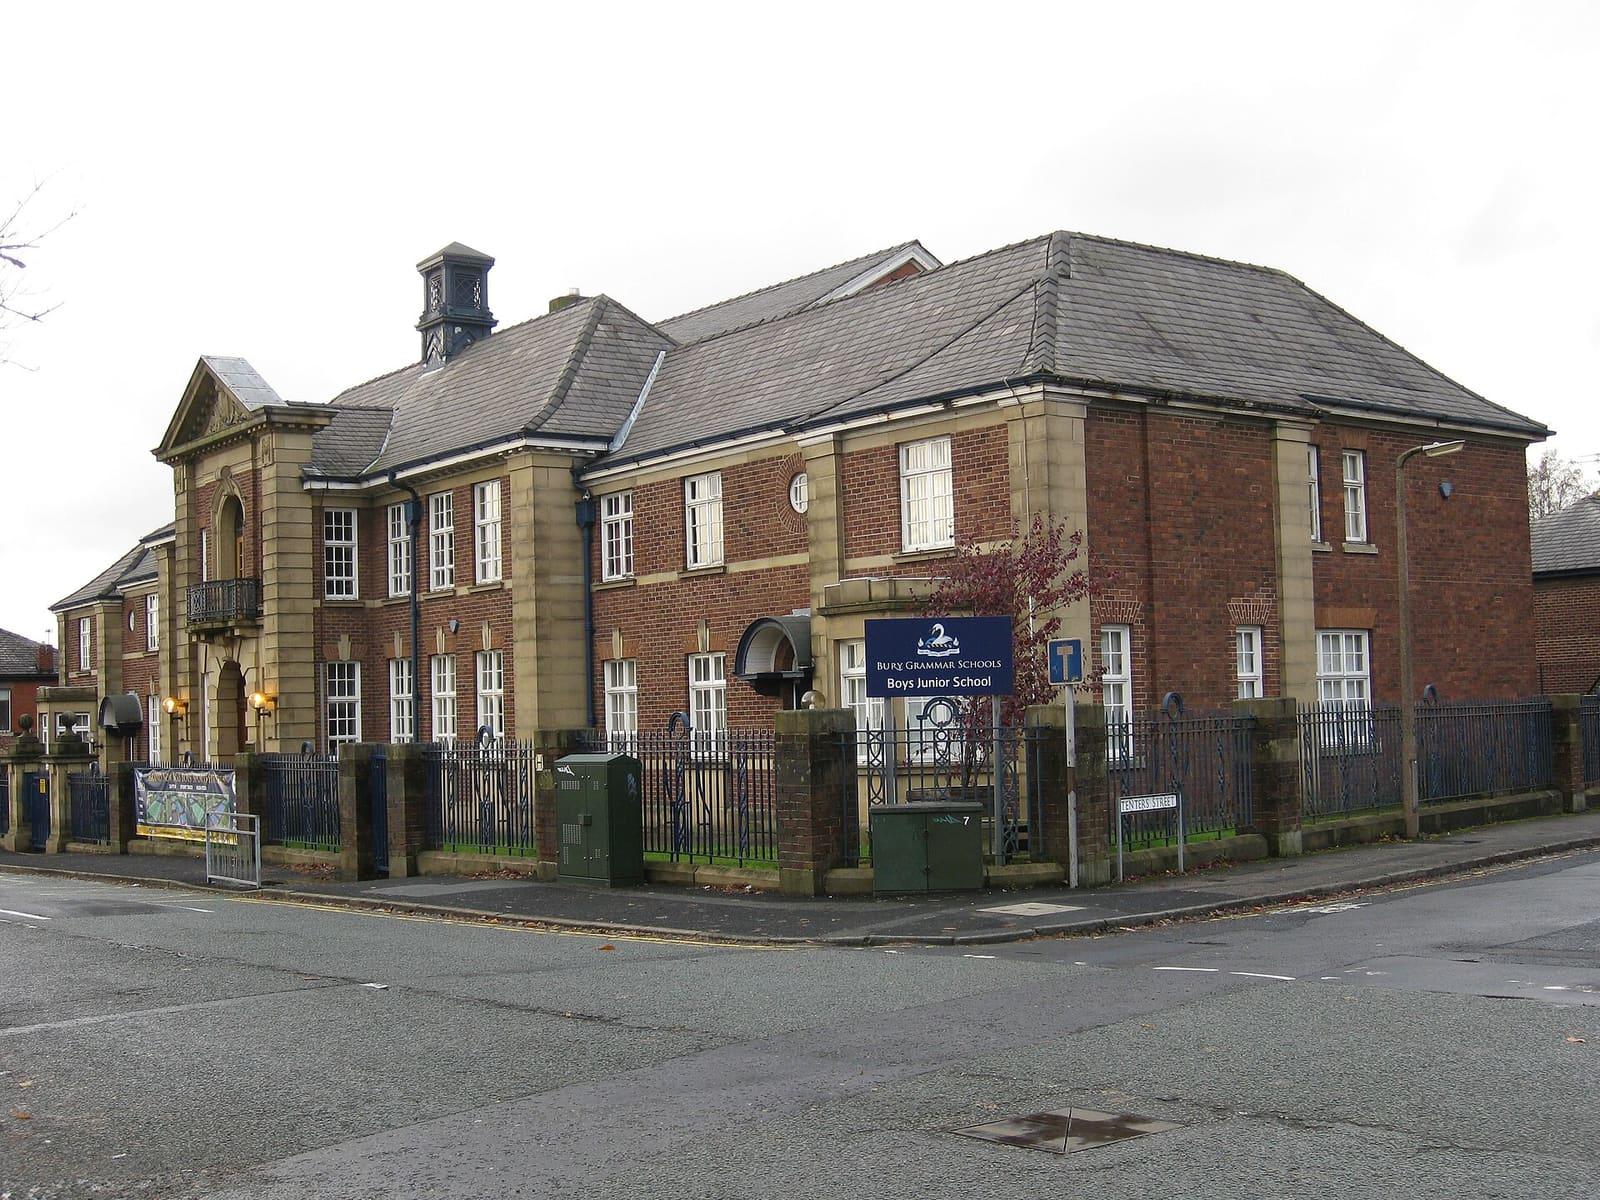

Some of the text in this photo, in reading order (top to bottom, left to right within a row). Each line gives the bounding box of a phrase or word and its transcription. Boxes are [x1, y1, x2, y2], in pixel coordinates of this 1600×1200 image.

[887, 675, 991, 691] Boys Junior School
[1122, 797, 1175, 810] TENTERS STREET
[963, 816, 970, 826] 7
